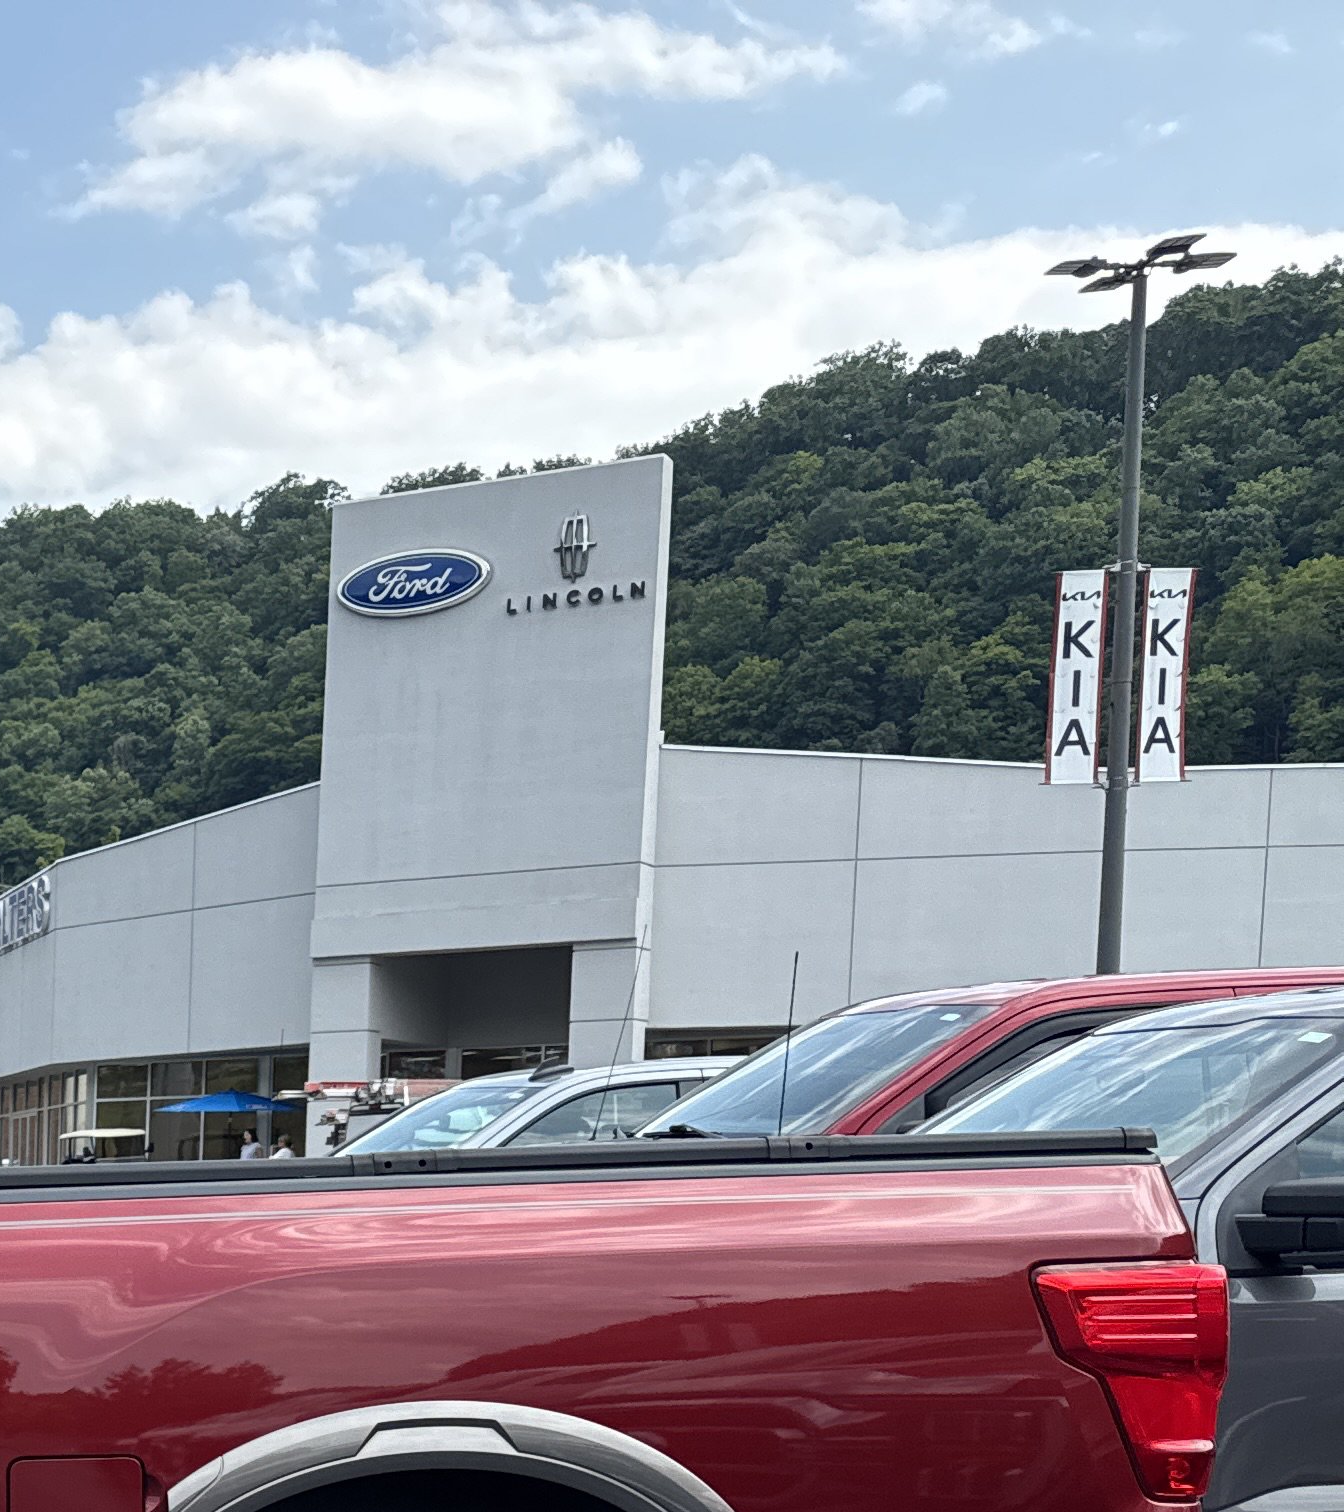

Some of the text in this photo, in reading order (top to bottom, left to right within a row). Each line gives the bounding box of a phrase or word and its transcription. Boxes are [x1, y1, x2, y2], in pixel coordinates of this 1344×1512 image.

[368, 562, 454, 603] Ford
[506, 580, 646, 616] LINCOLN
[1053, 619, 1097, 757] KIA
[1142, 618, 1182, 755] KIA
